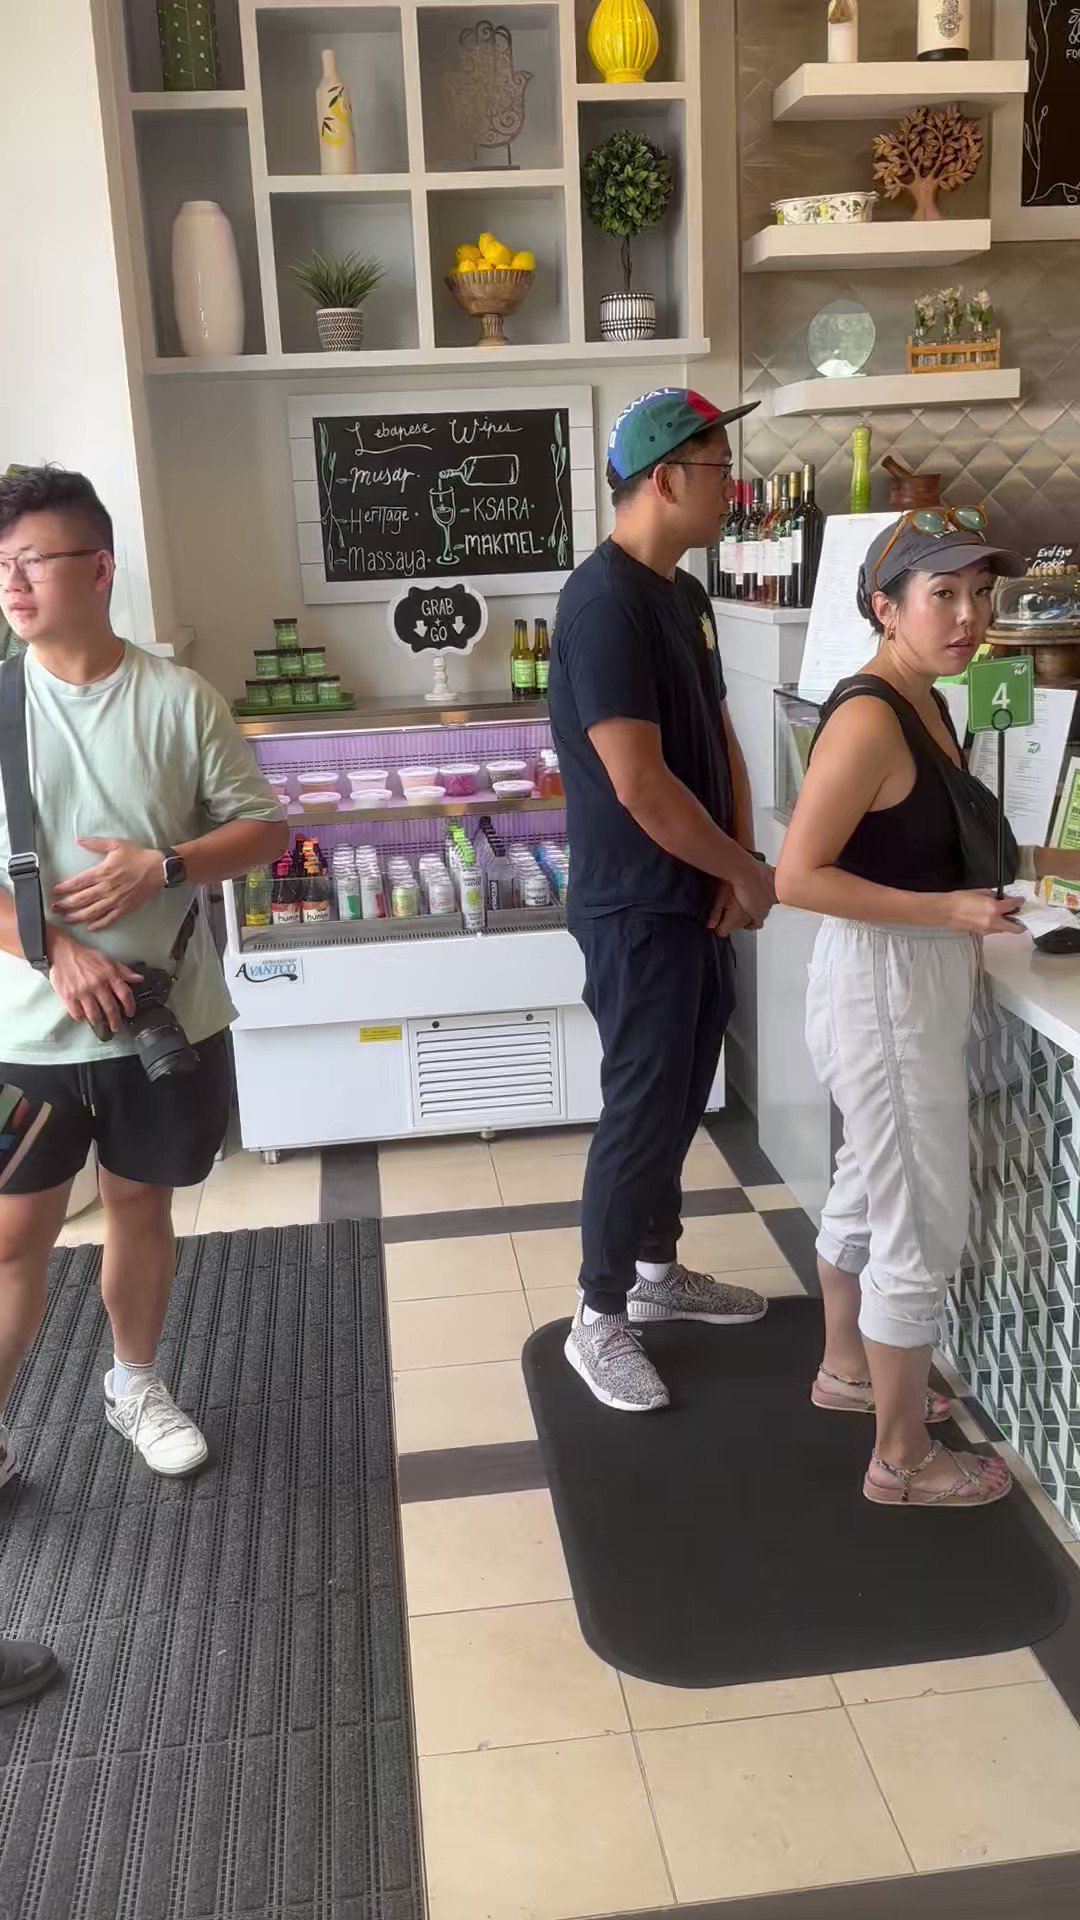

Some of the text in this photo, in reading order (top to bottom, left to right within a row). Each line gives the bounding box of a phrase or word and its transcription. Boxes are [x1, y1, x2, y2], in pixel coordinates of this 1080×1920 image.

[472, 496, 530, 521] KSARA
[464, 530, 543, 556] MAKMEL
[348, 546, 427, 577] Massaya
[421, 597, 455, 617] GRAB
[430, 626, 448, 642] GO
[991, 682, 1011, 710] 4
